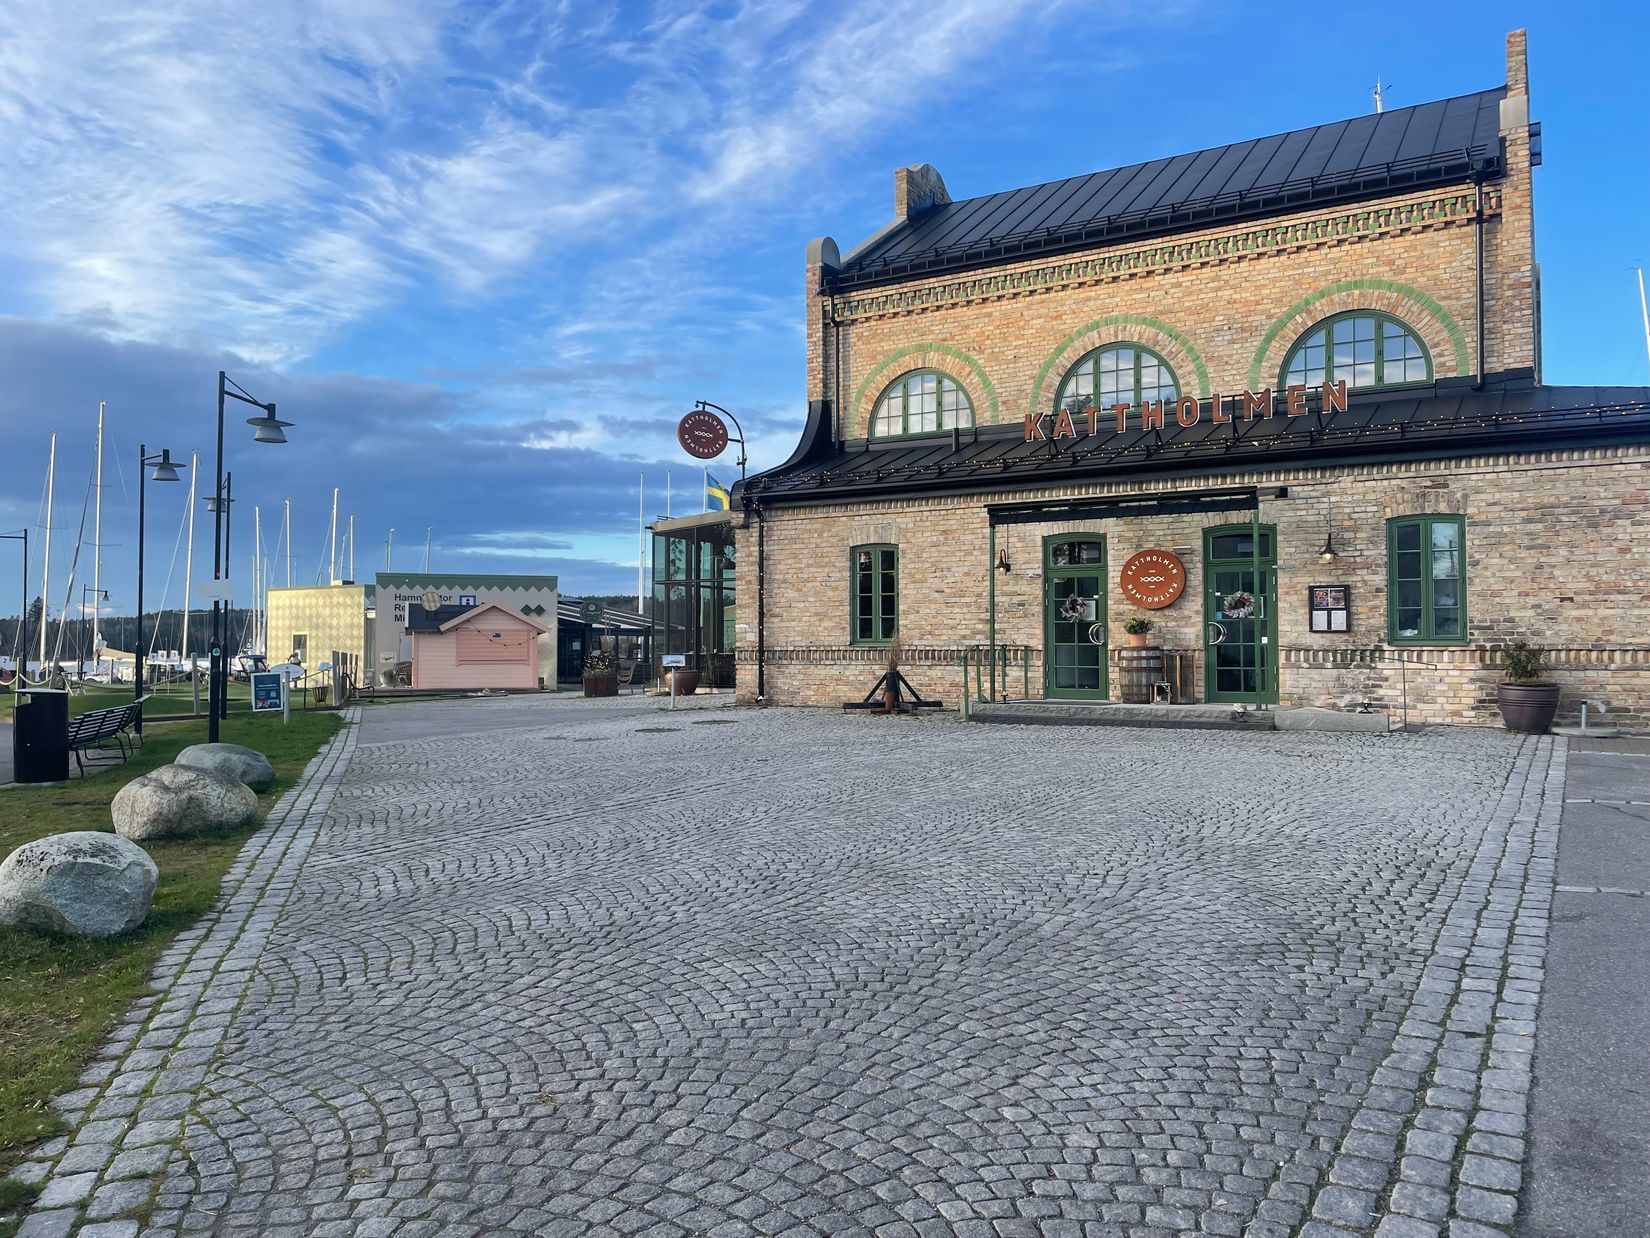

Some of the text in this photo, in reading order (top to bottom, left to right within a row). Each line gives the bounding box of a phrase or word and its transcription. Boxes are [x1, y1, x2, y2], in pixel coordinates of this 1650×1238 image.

[1024, 380, 1347, 441] KATTHOLMEN
[685, 415, 723, 434] KATTHOLMEN
[1127, 555, 1178, 576] KATTHOLMEN
[394, 593, 453, 602] Hamntor
[1127, 583, 1178, 603] KATTHOLMEN
